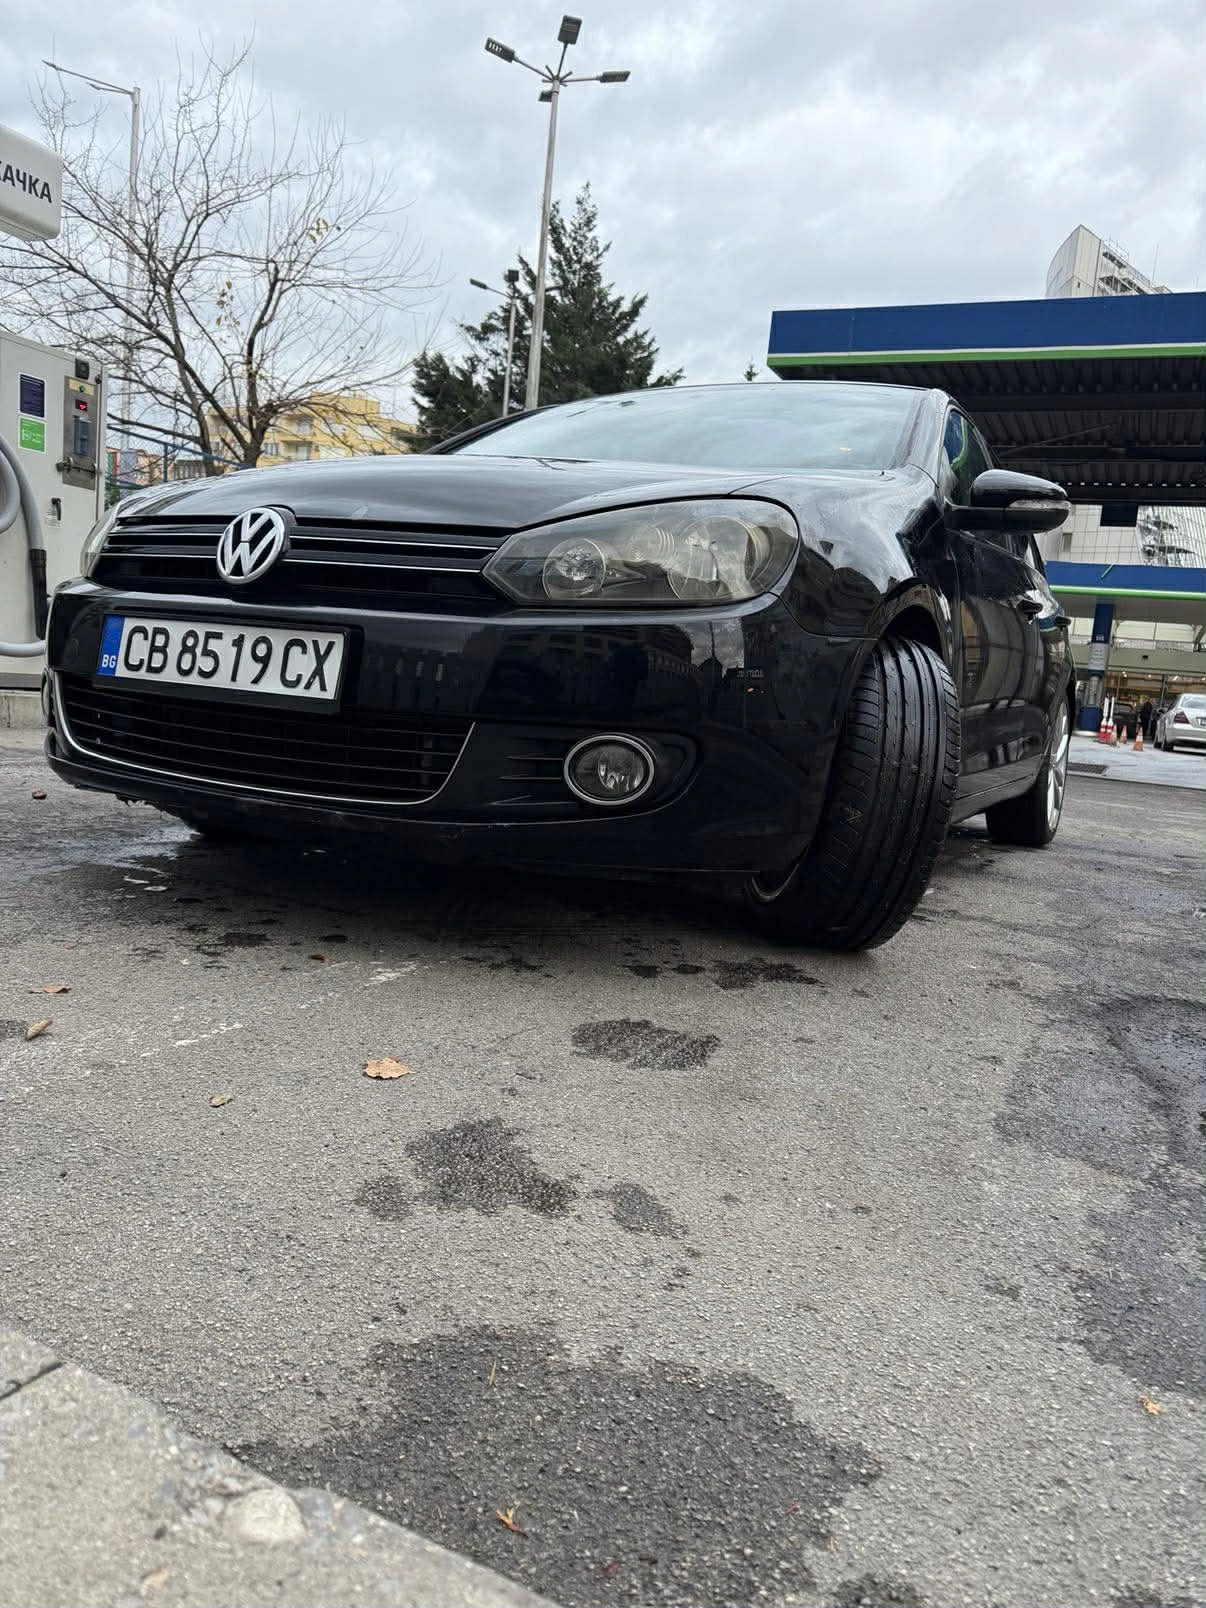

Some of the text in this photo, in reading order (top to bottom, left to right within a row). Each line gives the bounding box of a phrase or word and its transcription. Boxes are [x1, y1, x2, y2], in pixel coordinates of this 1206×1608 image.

[0, 161, 52, 203] АЧКА
[218, 508, 284, 581] VW
[102, 654, 116, 668] BG
